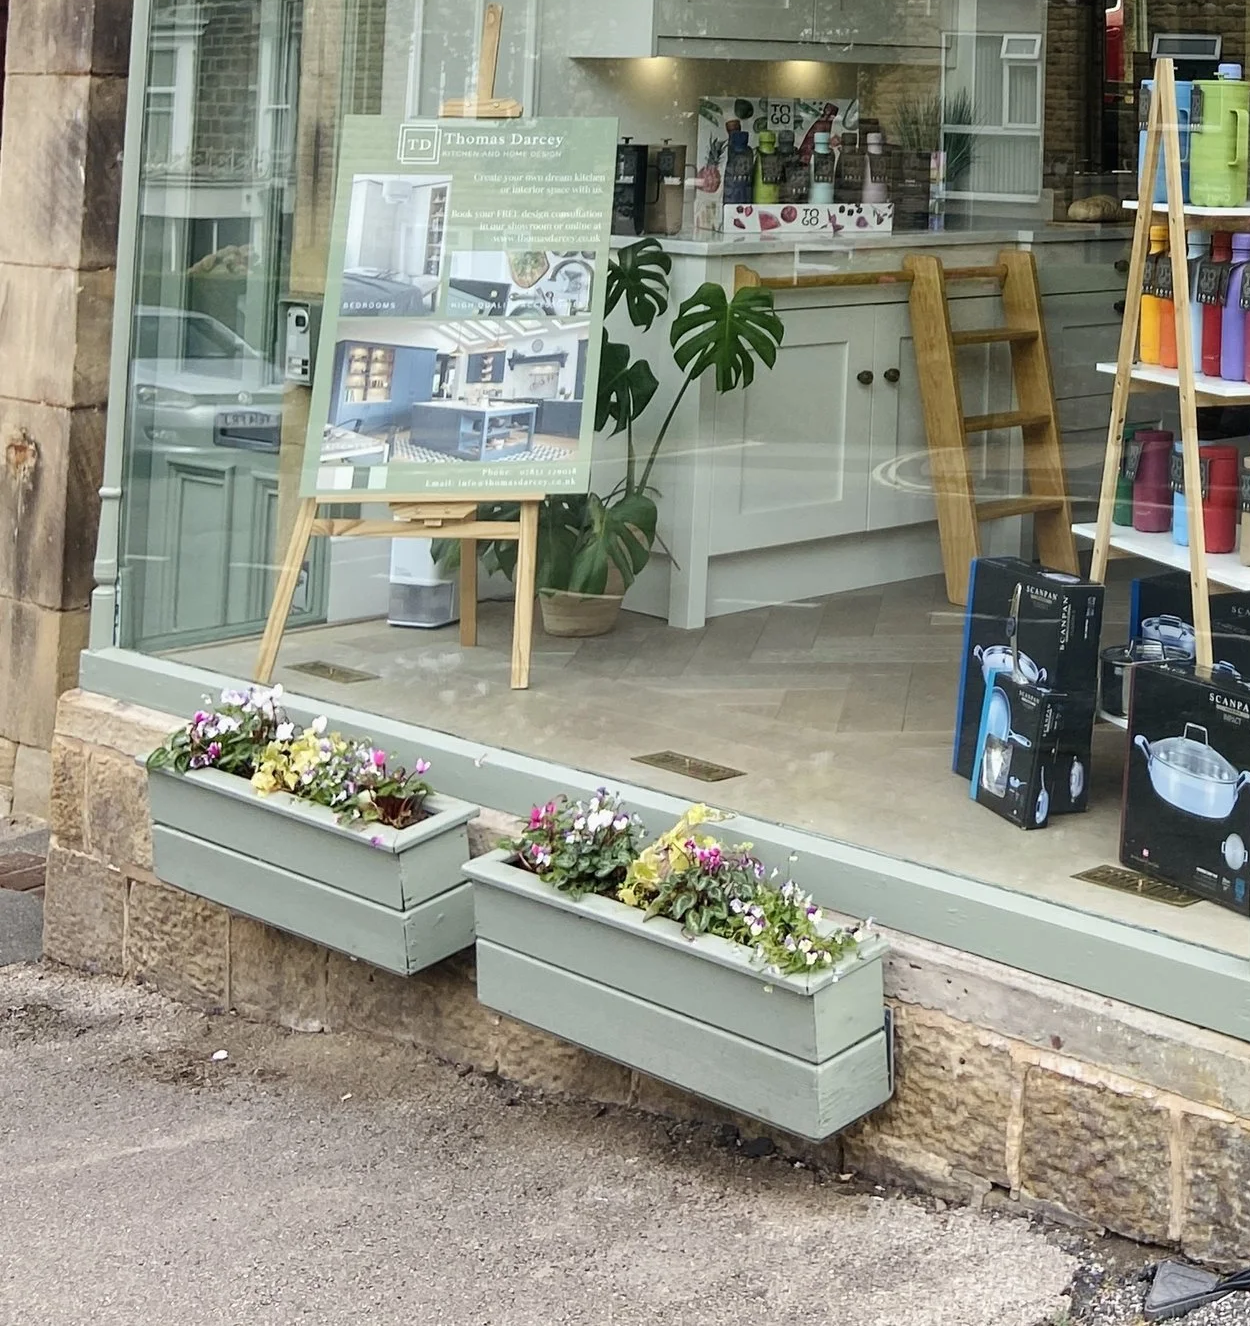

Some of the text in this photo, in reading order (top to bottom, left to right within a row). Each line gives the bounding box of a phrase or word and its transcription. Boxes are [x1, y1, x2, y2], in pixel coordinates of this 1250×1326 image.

[770, 113, 791, 125] GO
[407, 138, 432, 151] TD
[443, 132, 565, 149] Thomas Darcey
[441, 149, 563, 159] KITCHEN AND HOME DESIGN
[801, 216, 820, 226] GO
[342, 301, 397, 309] BEDROOMS
[450, 301, 475, 309] HIGH
[1025, 584, 1058, 601] SCANPAN
[1060, 595, 1069, 651] SCANPAN
